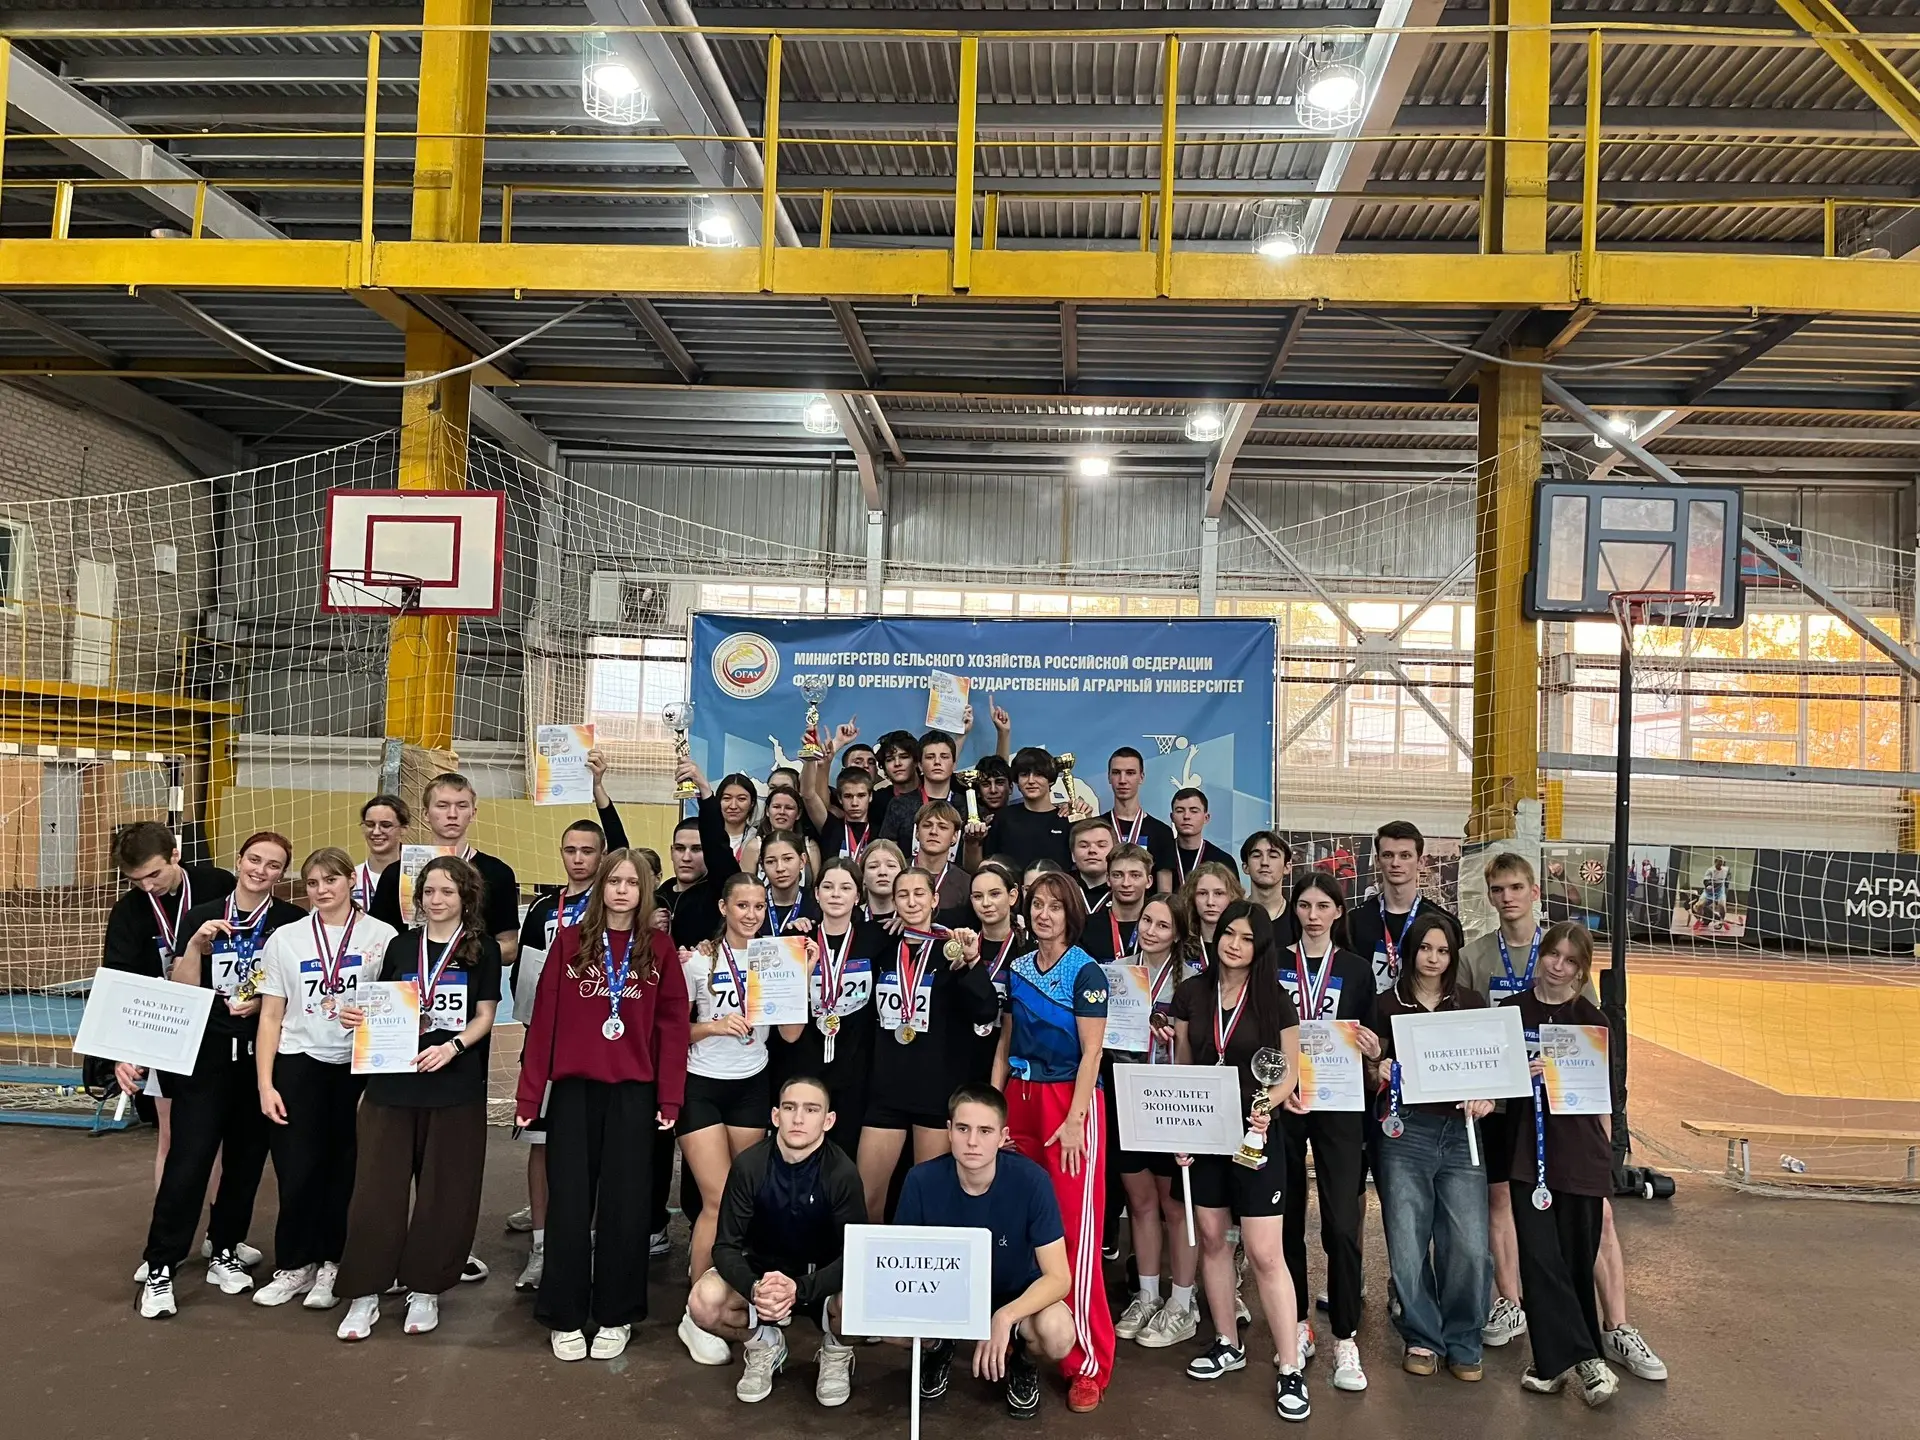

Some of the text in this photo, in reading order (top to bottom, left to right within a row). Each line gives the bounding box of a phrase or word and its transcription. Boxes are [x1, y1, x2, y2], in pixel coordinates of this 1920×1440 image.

[793, 652, 1213, 672] МИНИСТЕРСТВО СЕЛЬСКОГО ХОЗЯЙСТВА РОССИЙСКОЙ ФЕДЕРАЦИИ
[734, 670, 761, 679] ОГАУ
[838, 675, 855, 687] ВО
[967, 677, 1080, 692] СУДАРСТВЕННЫЙ
[1082, 677, 1152, 693] АГРАРНЫЙ
[1155, 679, 1244, 693] УНИВЕРСИТЕТ
[1854, 877, 1920, 897] АГРА
[133, 998, 185, 1014] ФАКУЛЬТЕТ
[878, 991, 927, 1013] 702
[1109, 998, 1141, 1007] РАМОТА
[122, 1006, 190, 1026] ВЕТЕРИНАРНОЙ
[366, 1016, 407, 1026] ГРАМОТА
[128, 1019, 179, 1035] МЕДИЦИНЫ
[1423, 1045, 1500, 1059] ИНЖЕНЕРНЫЙ
[1310, 1055, 1350, 1065] ГРАМОТА
[1428, 1060, 1499, 1072] ФАКУЛЬТЕТ
[1554, 1059, 1596, 1067] ГРАМОТА
[1143, 1088, 1211, 1100] ФАКУЛЬТЕТ
[1141, 1102, 1214, 1114] ЭКОНОМИКИ
[1155, 1117, 1203, 1127] И ПРАВА
[876, 1256, 961, 1271] КОЛЛЕДЖ
[895, 1280, 941, 1294] ОГАУ
